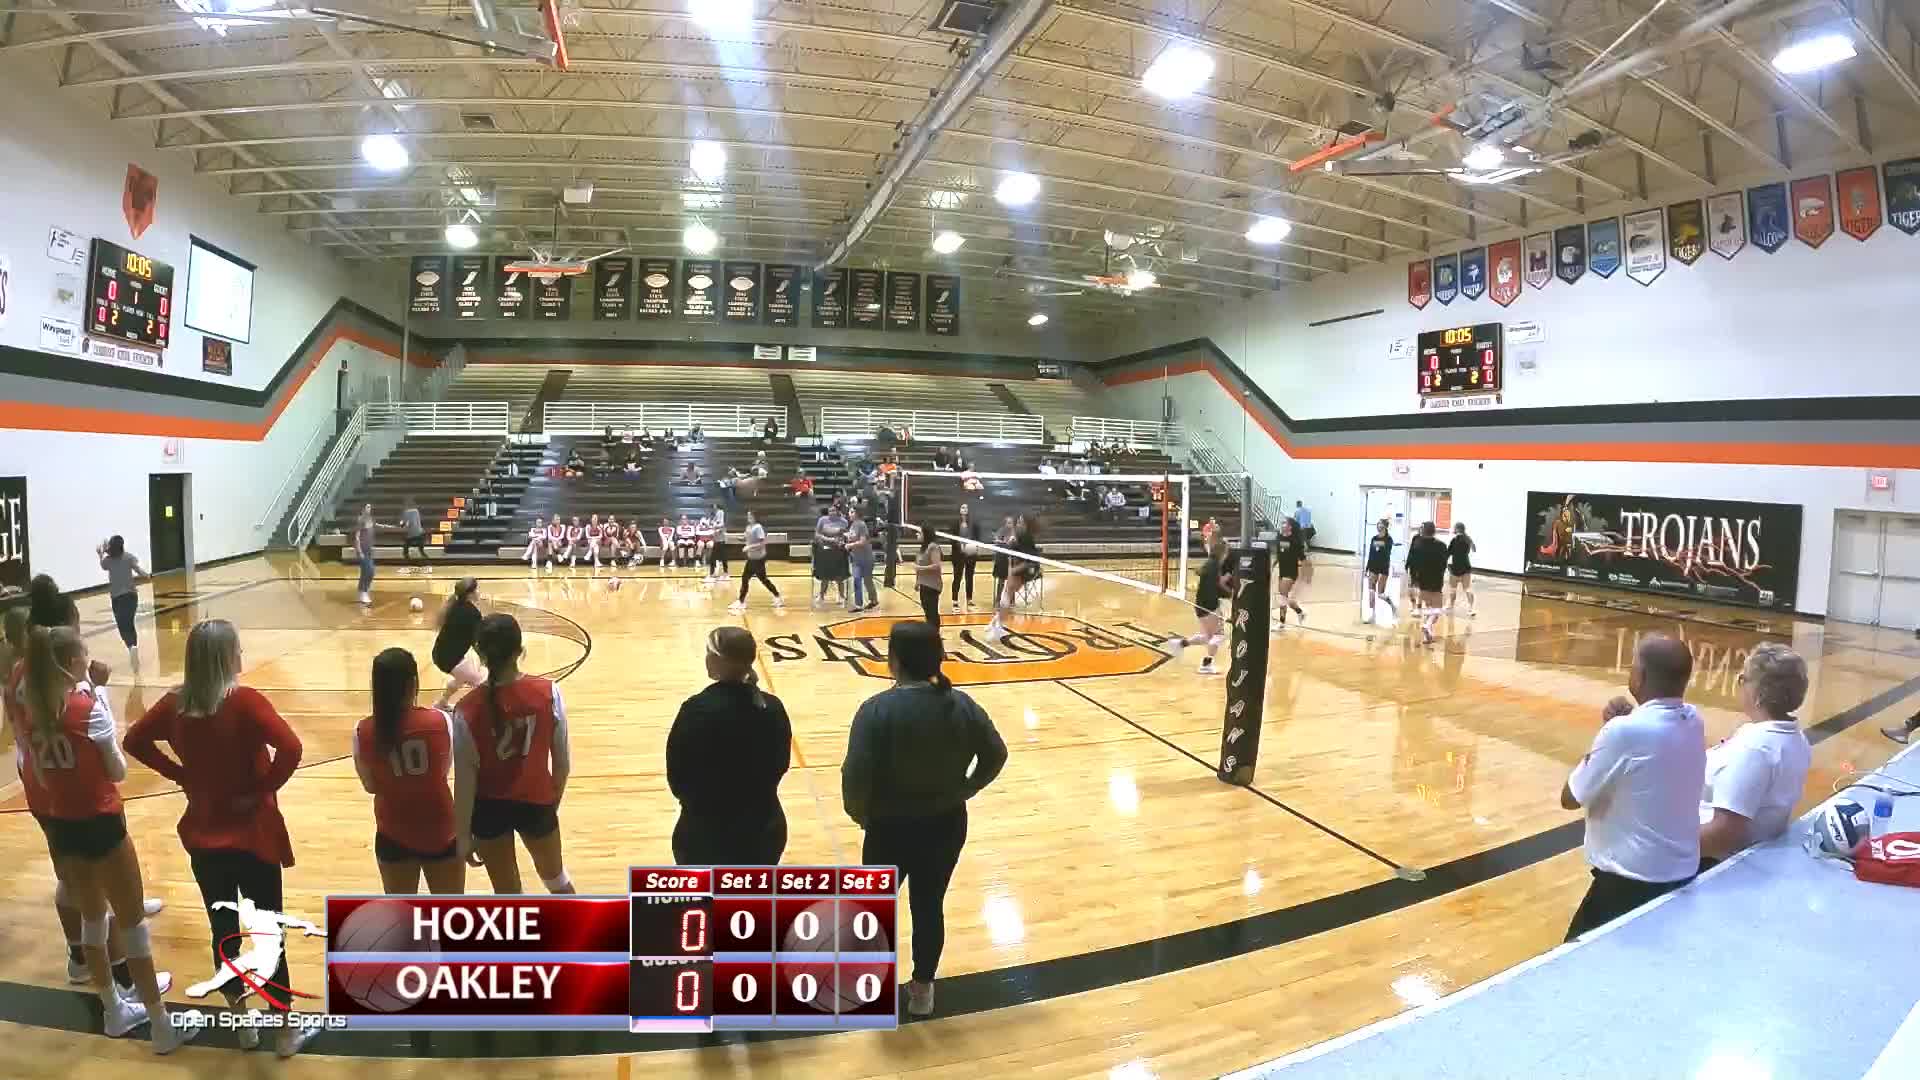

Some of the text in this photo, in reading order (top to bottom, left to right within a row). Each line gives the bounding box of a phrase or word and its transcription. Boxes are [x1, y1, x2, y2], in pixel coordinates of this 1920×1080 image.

[127, 253, 152, 278] 10:05
[108, 280, 117, 300] 0
[160, 297, 168, 315] 0
[111, 310, 118, 325] 2
[147, 320, 153, 334] 2
[1445, 327, 1472, 344] 10:05
[1430, 356, 1438, 369] 0
[1485, 350, 1493, 364] 0
[1471, 371, 1479, 384] 2
[1620, 507, 1761, 577] TROJANS
[764, 622, 1187, 664] TROJNS
